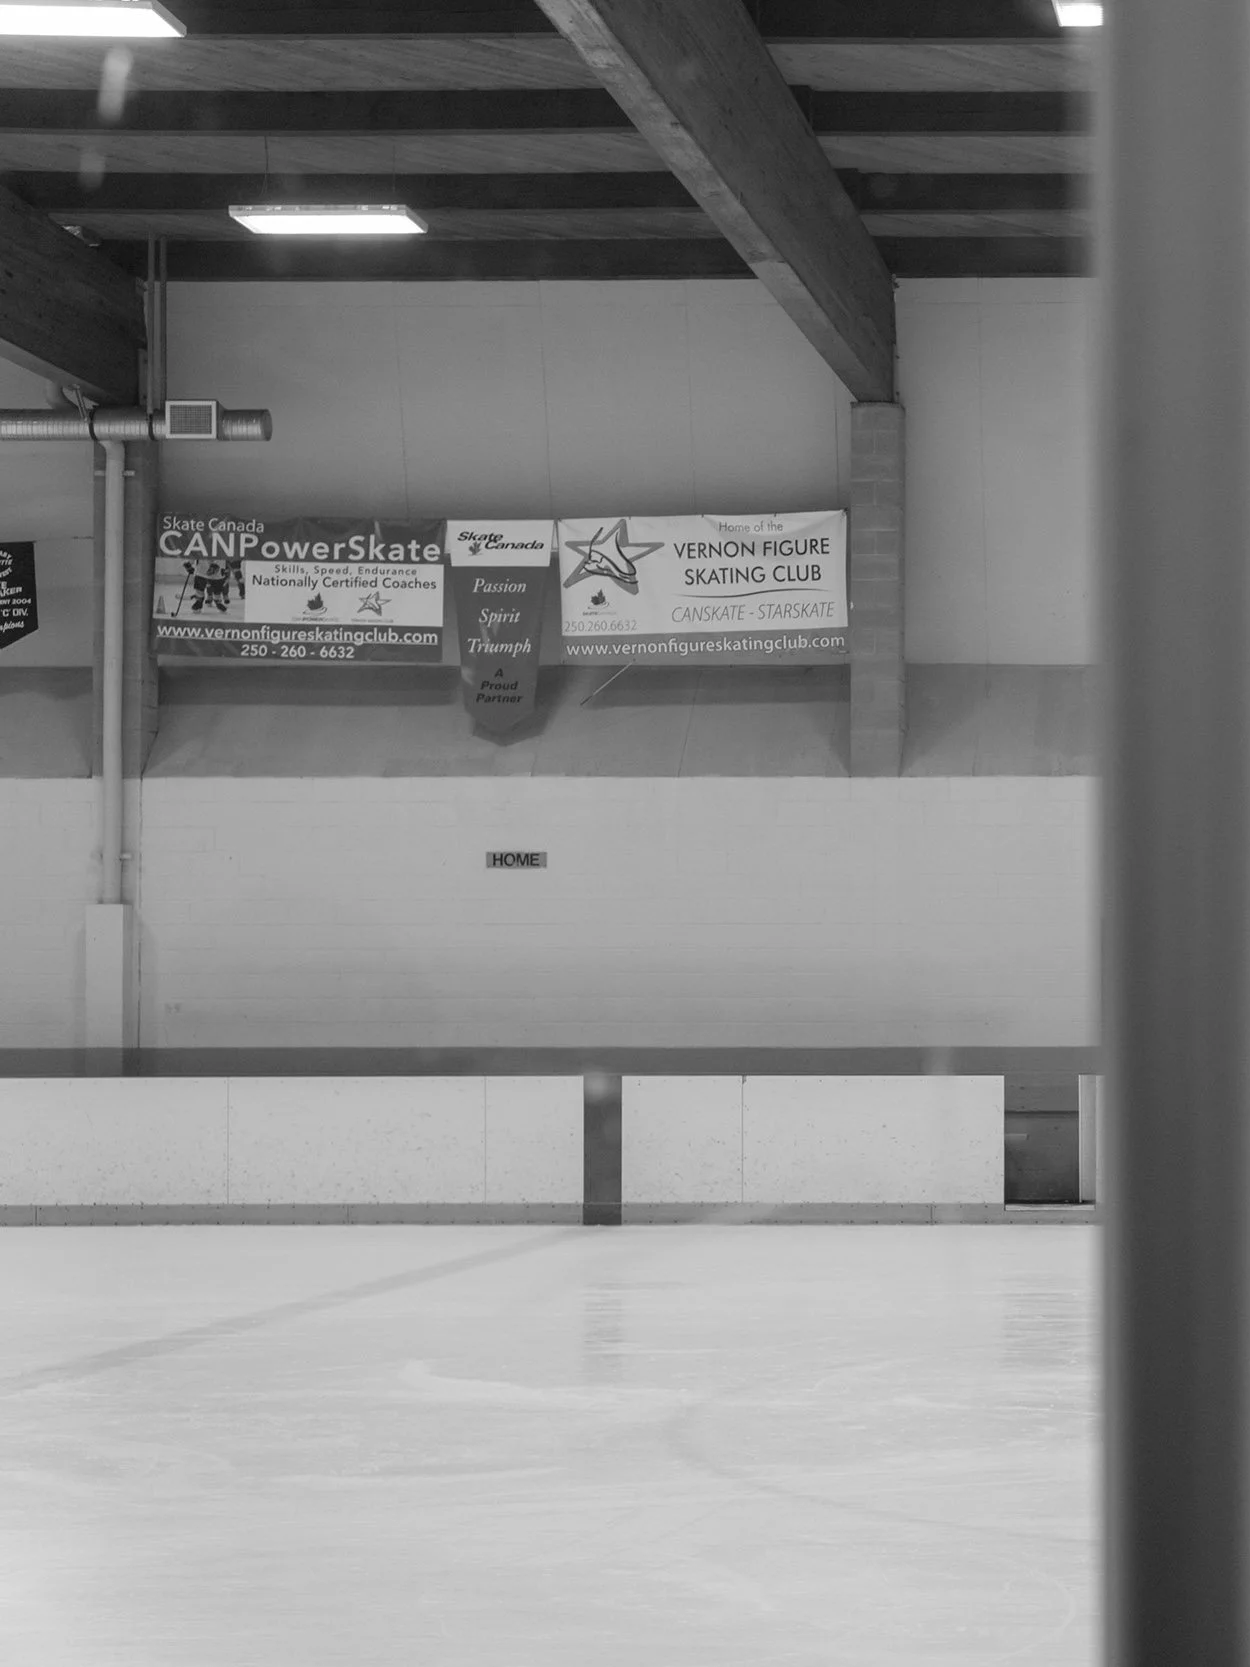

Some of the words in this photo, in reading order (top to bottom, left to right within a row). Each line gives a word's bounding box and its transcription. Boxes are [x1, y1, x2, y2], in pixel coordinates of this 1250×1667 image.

[163, 516, 205, 530] Skate
[208, 518, 265, 533] Canada
[719, 521, 749, 533] Home
[754, 521, 765, 533] of
[767, 521, 784, 532] the
[457, 531, 505, 543] Skate
[159, 530, 441, 562] CANPowerSkate
[485, 541, 546, 551] Canada
[673, 541, 756, 559] VERNON
[763, 538, 831, 557] FIGURE
[275, 564, 309, 576] Skills,
[314, 565, 352, 578] Speed,
[358, 566, 417, 576] Endurance
[684, 566, 767, 586] SKATING
[773, 565, 823, 582] CLUB
[252, 574, 319, 591] Nationally
[323, 576, 378, 589] Certified
[382, 577, 438, 590] Coaches
[472, 577, 527, 593] Passion
[478, 608, 521, 628] Spirit
[671, 605, 747, 622] CANSKATE
[757, 602, 837, 620] STARSKATE
[564, 619, 638, 633] 250.260.6632
[157, 624, 439, 646] www.vernonfigureskatingclub.com
[241, 644, 268, 657] 250
[281, 645, 308, 658] 260
[320, 646, 356, 659] 6632
[467, 637, 532, 658] Triumph
[566, 635, 847, 657] www.vernonfigureskatingclub.com
[494, 667, 504, 679] A
[480, 680, 519, 691] Proud
[475, 693, 523, 704] Partner
[492, 853, 540, 867] HOME
